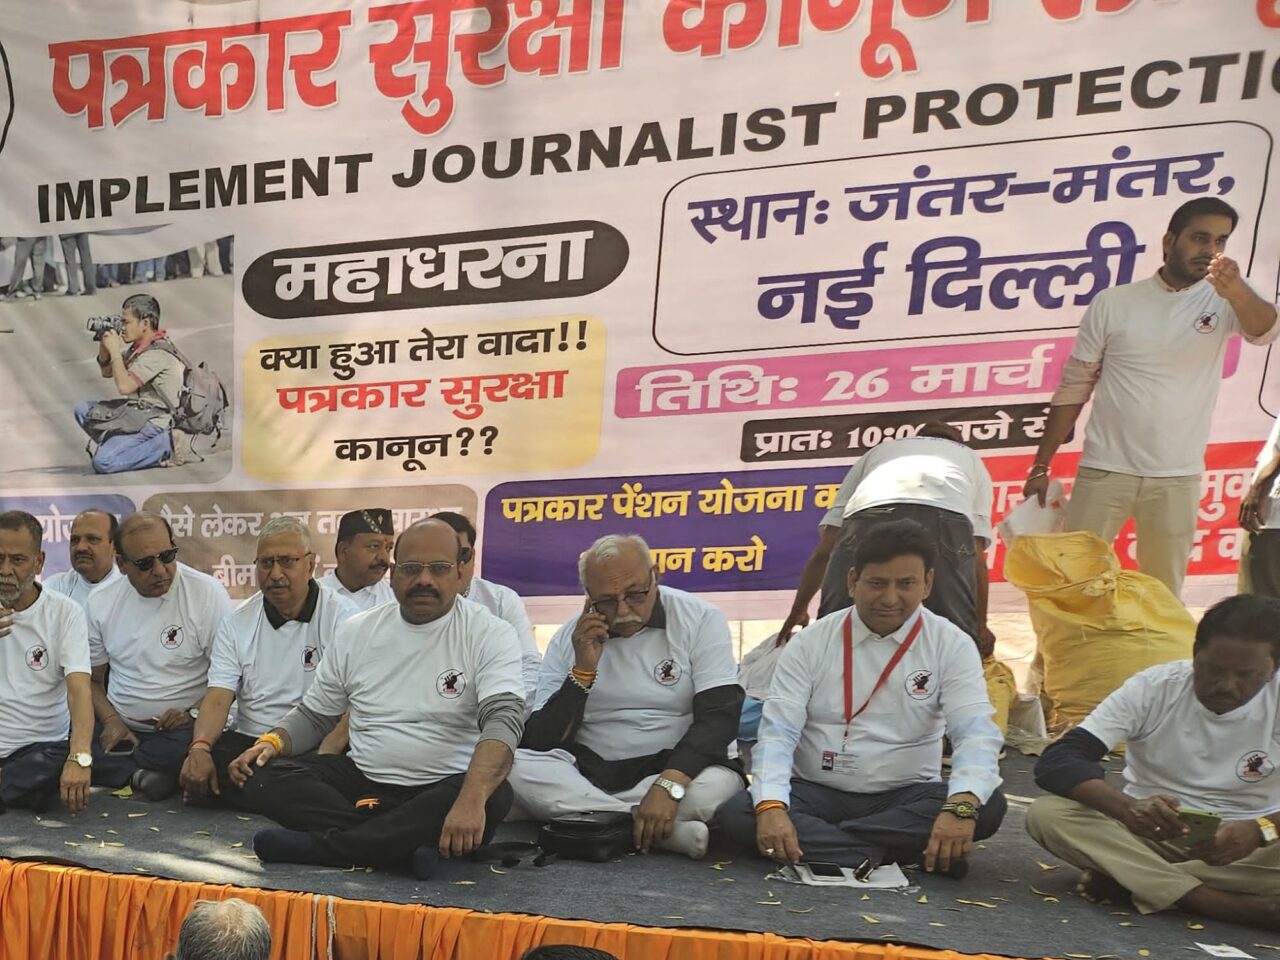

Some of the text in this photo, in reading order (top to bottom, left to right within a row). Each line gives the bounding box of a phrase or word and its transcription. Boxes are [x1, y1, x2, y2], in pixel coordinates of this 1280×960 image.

[49, 11, 351, 128] पत्रकार
[38, 50, 1280, 223] IMPLEMENT JOURNALIST PROTECTI
[273, 230, 594, 303] महाधरना
[757, 220, 1147, 330] नई दिल्ली
[260, 320, 588, 380] क्या हुआ तेरा वादा!!
[820, 367, 890, 402] 26
[911, 343, 1053, 394] मार्च
[276, 370, 569, 420] पत्रकार सुरक्षा
[334, 426, 499, 471] कानून??
[200, 504, 264, 538] लेकर
[502, 494, 607, 523] पत्रकार
[612, 482, 693, 519] पेंशन
[699, 479, 807, 515] योजना
[702, 535, 767, 573] करो
